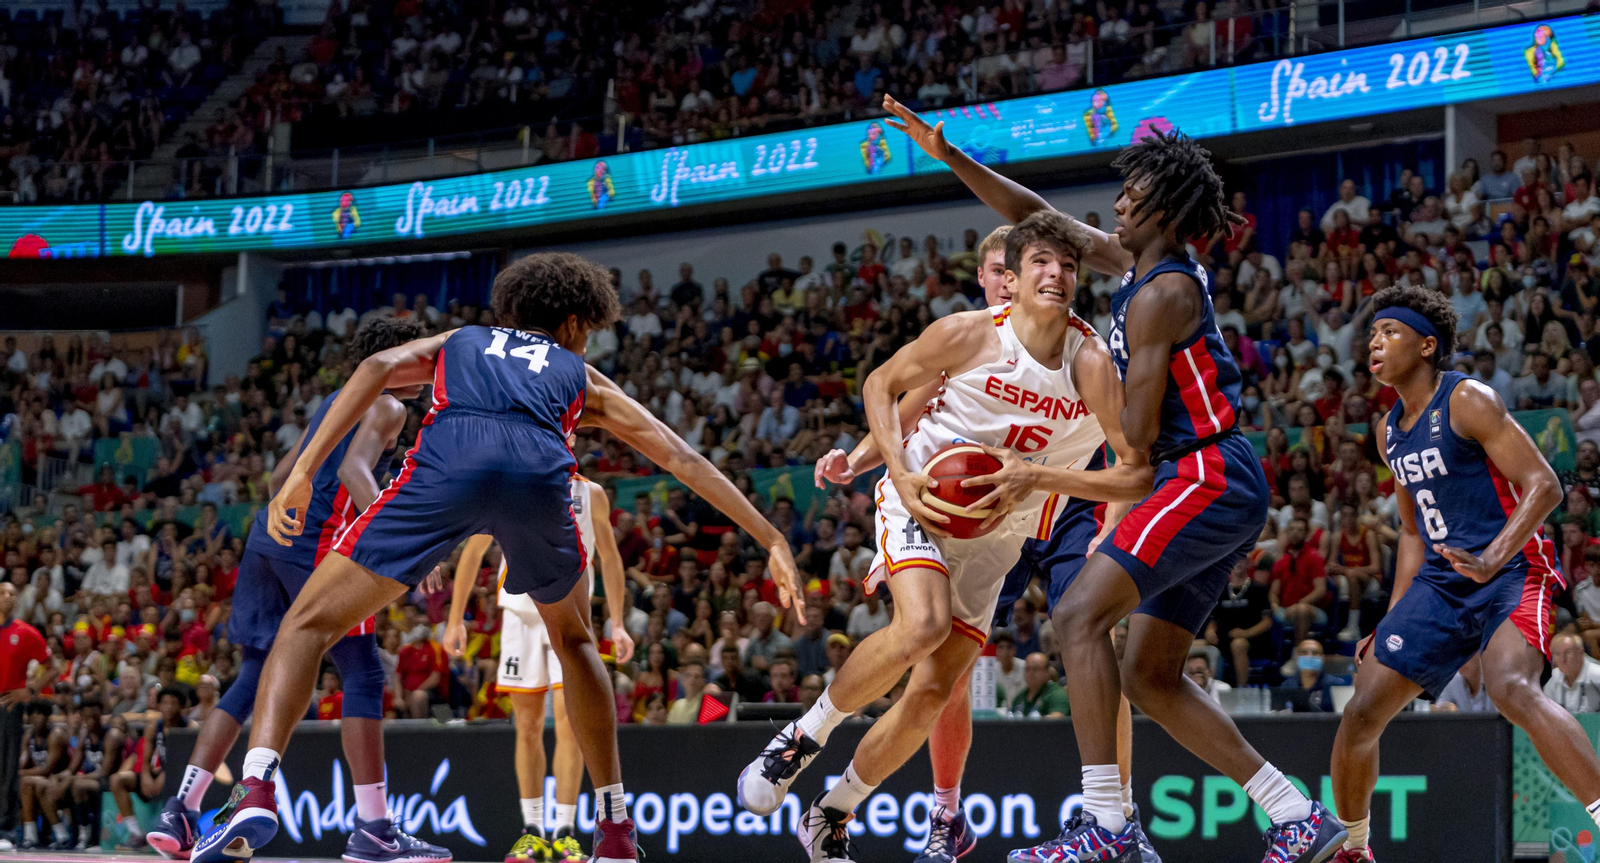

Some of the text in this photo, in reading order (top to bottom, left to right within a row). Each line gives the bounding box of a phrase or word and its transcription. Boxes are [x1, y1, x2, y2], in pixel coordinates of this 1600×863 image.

[1258, 43, 1471, 124] Spain 2022
[651, 137, 819, 207] Spain 2022
[123, 201, 294, 257] Spain 2022
[396, 175, 551, 238] Spain 2022
[484, 329, 550, 374] 14
[985, 375, 1092, 421] ESPAÑA
[1003, 423, 1053, 453] 16
[1390, 447, 1449, 486] USA
[1416, 489, 1449, 540] 6
[824, 776, 1041, 853] egon
